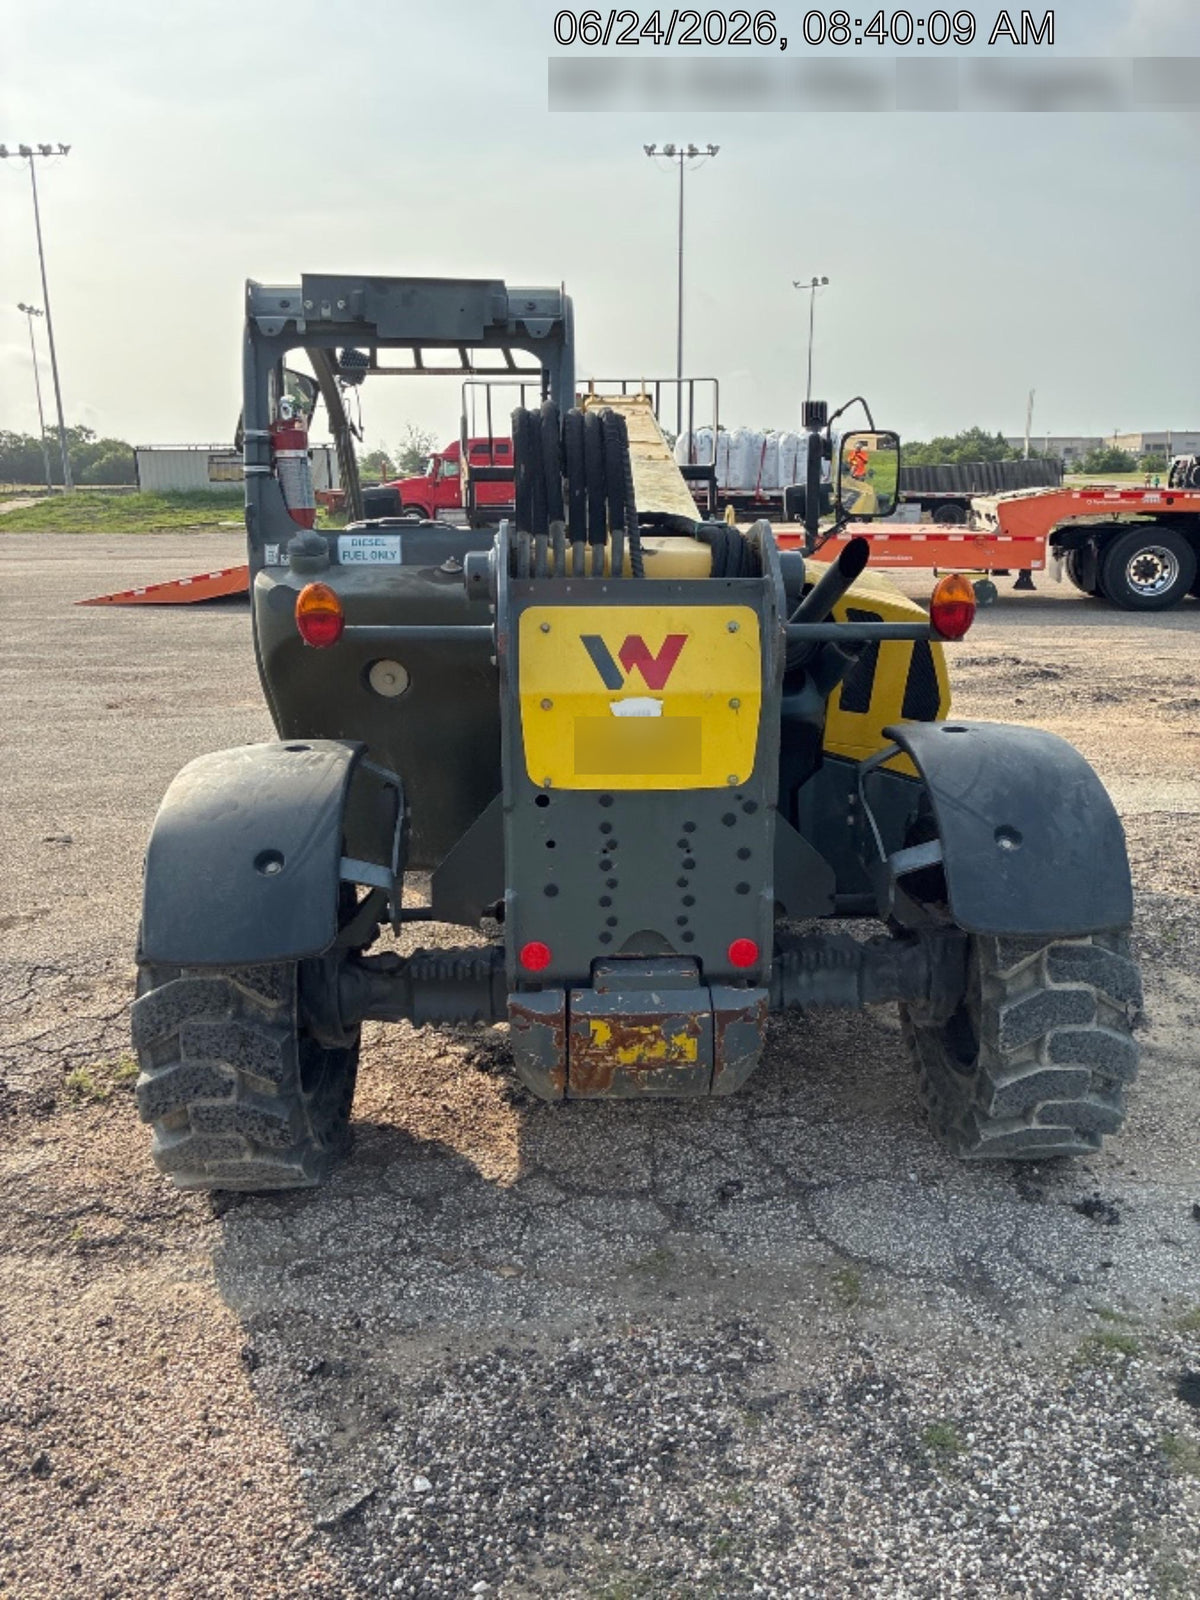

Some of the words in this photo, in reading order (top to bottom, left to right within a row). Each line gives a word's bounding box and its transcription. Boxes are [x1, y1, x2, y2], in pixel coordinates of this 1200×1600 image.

[351, 538, 388, 547] DIESEL
[342, 550, 369, 561] FUEL
[369, 550, 398, 561] ONLY
